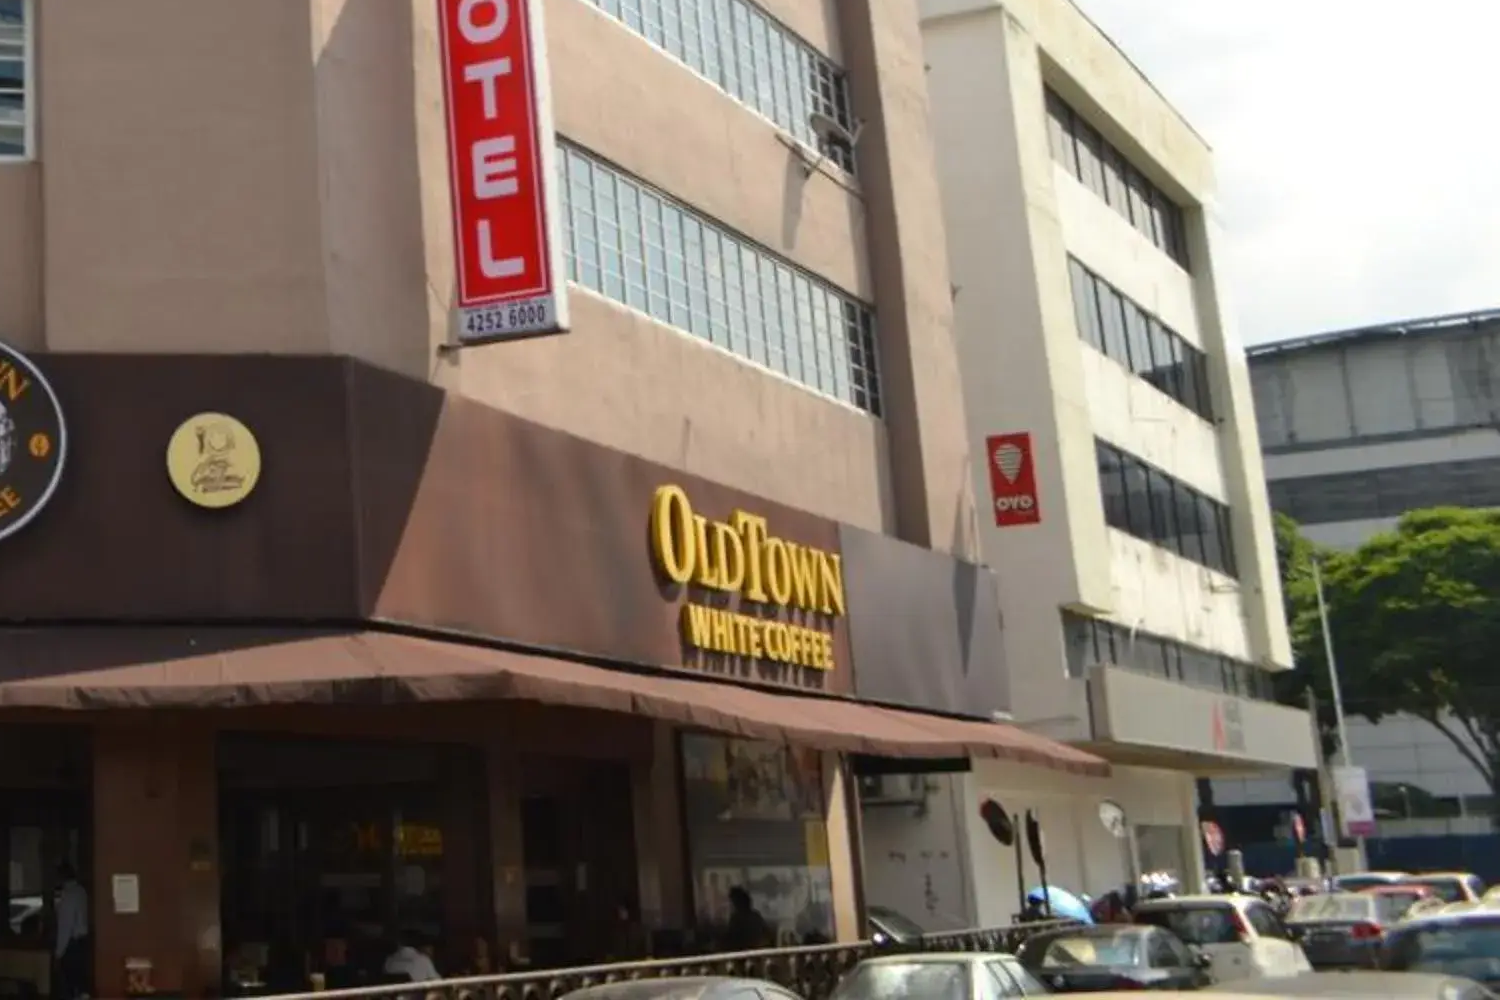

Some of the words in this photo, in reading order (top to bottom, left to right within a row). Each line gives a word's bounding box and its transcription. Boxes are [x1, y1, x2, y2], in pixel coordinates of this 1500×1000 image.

[466, 310, 502, 332] 4252
[508, 303, 545, 328] 6000
[996, 494, 1034, 511] OYO
[650, 484, 846, 617] OLDTOWN
[682, 602, 763, 660] WHITE
[762, 617, 835, 671] COFFEE
